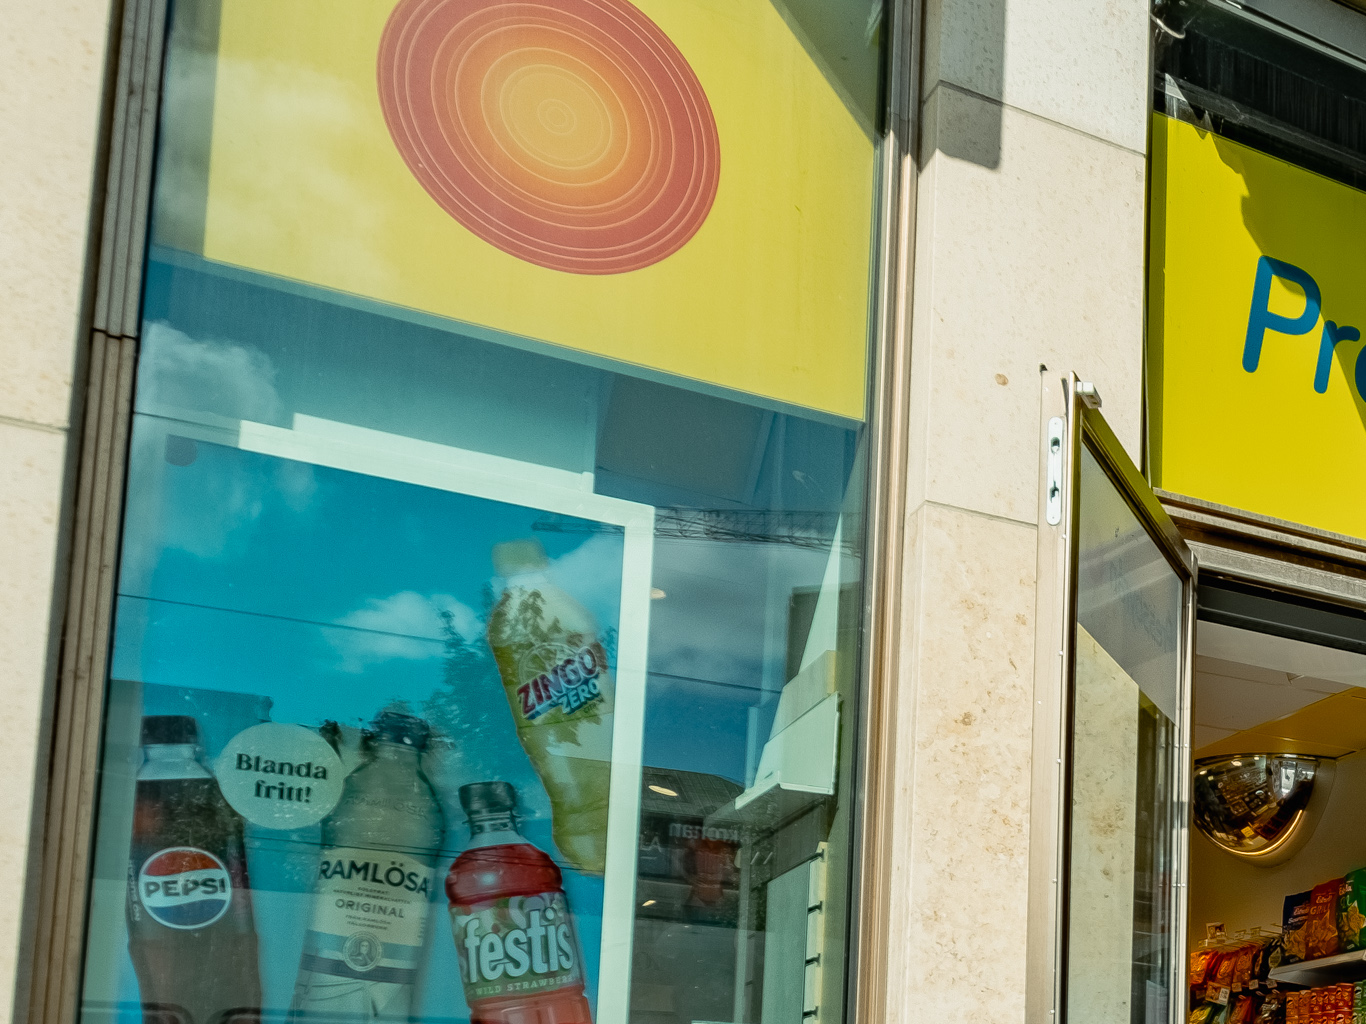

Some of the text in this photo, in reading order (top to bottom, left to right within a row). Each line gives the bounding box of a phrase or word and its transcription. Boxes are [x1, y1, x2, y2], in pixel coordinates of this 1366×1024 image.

[517, 647, 598, 716] ZINGO
[560, 678, 601, 714] ZERO
[235, 753, 328, 780] Blanda
[254, 780, 312, 803] fritt!
[144, 877, 227, 898] PEPSI
[318, 860, 430, 898] RAMLÖSA
[334, 899, 405, 918] ORIGINAL
[464, 908, 574, 984] festis
